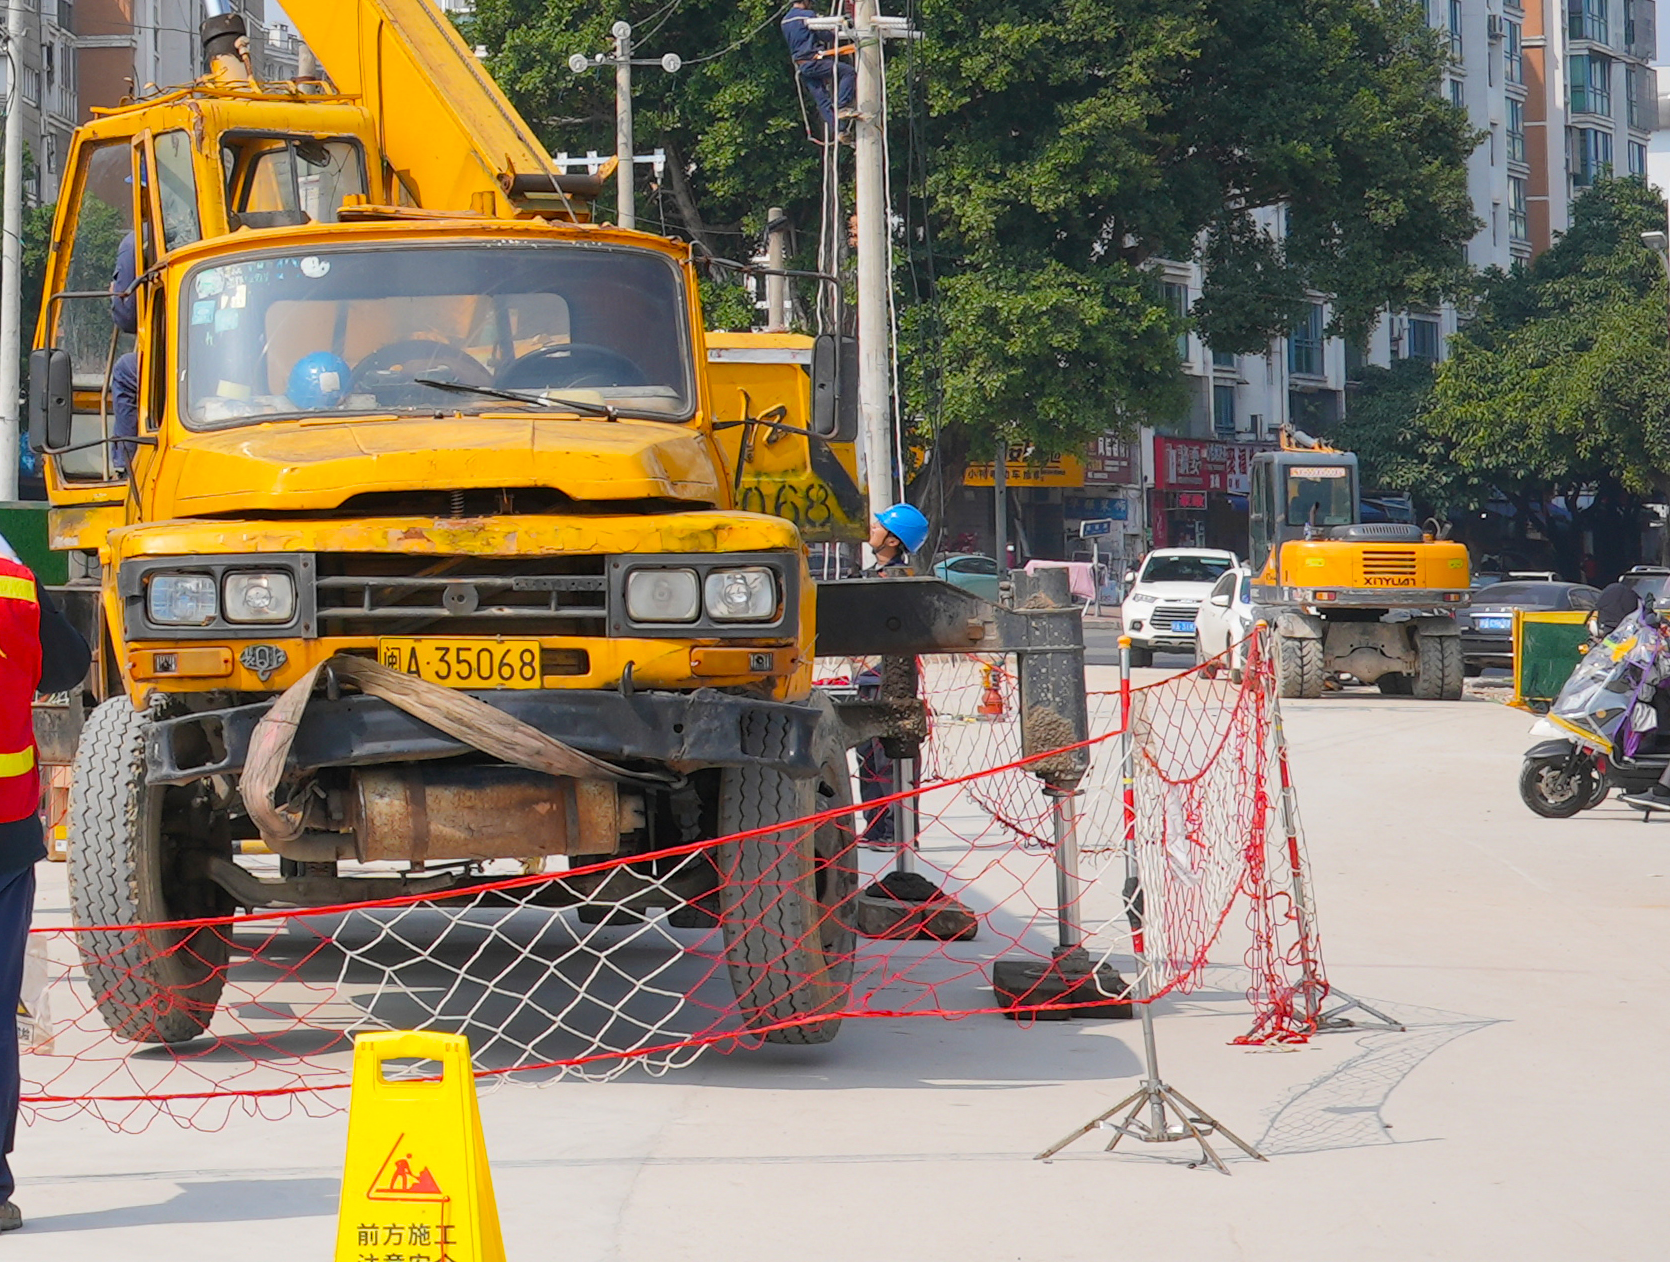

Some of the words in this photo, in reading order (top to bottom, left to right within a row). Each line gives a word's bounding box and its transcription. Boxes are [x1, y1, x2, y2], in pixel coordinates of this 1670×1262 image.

[384, 646, 536, 682] 闽A·35068
[357, 1223, 457, 1246] 前方施工
